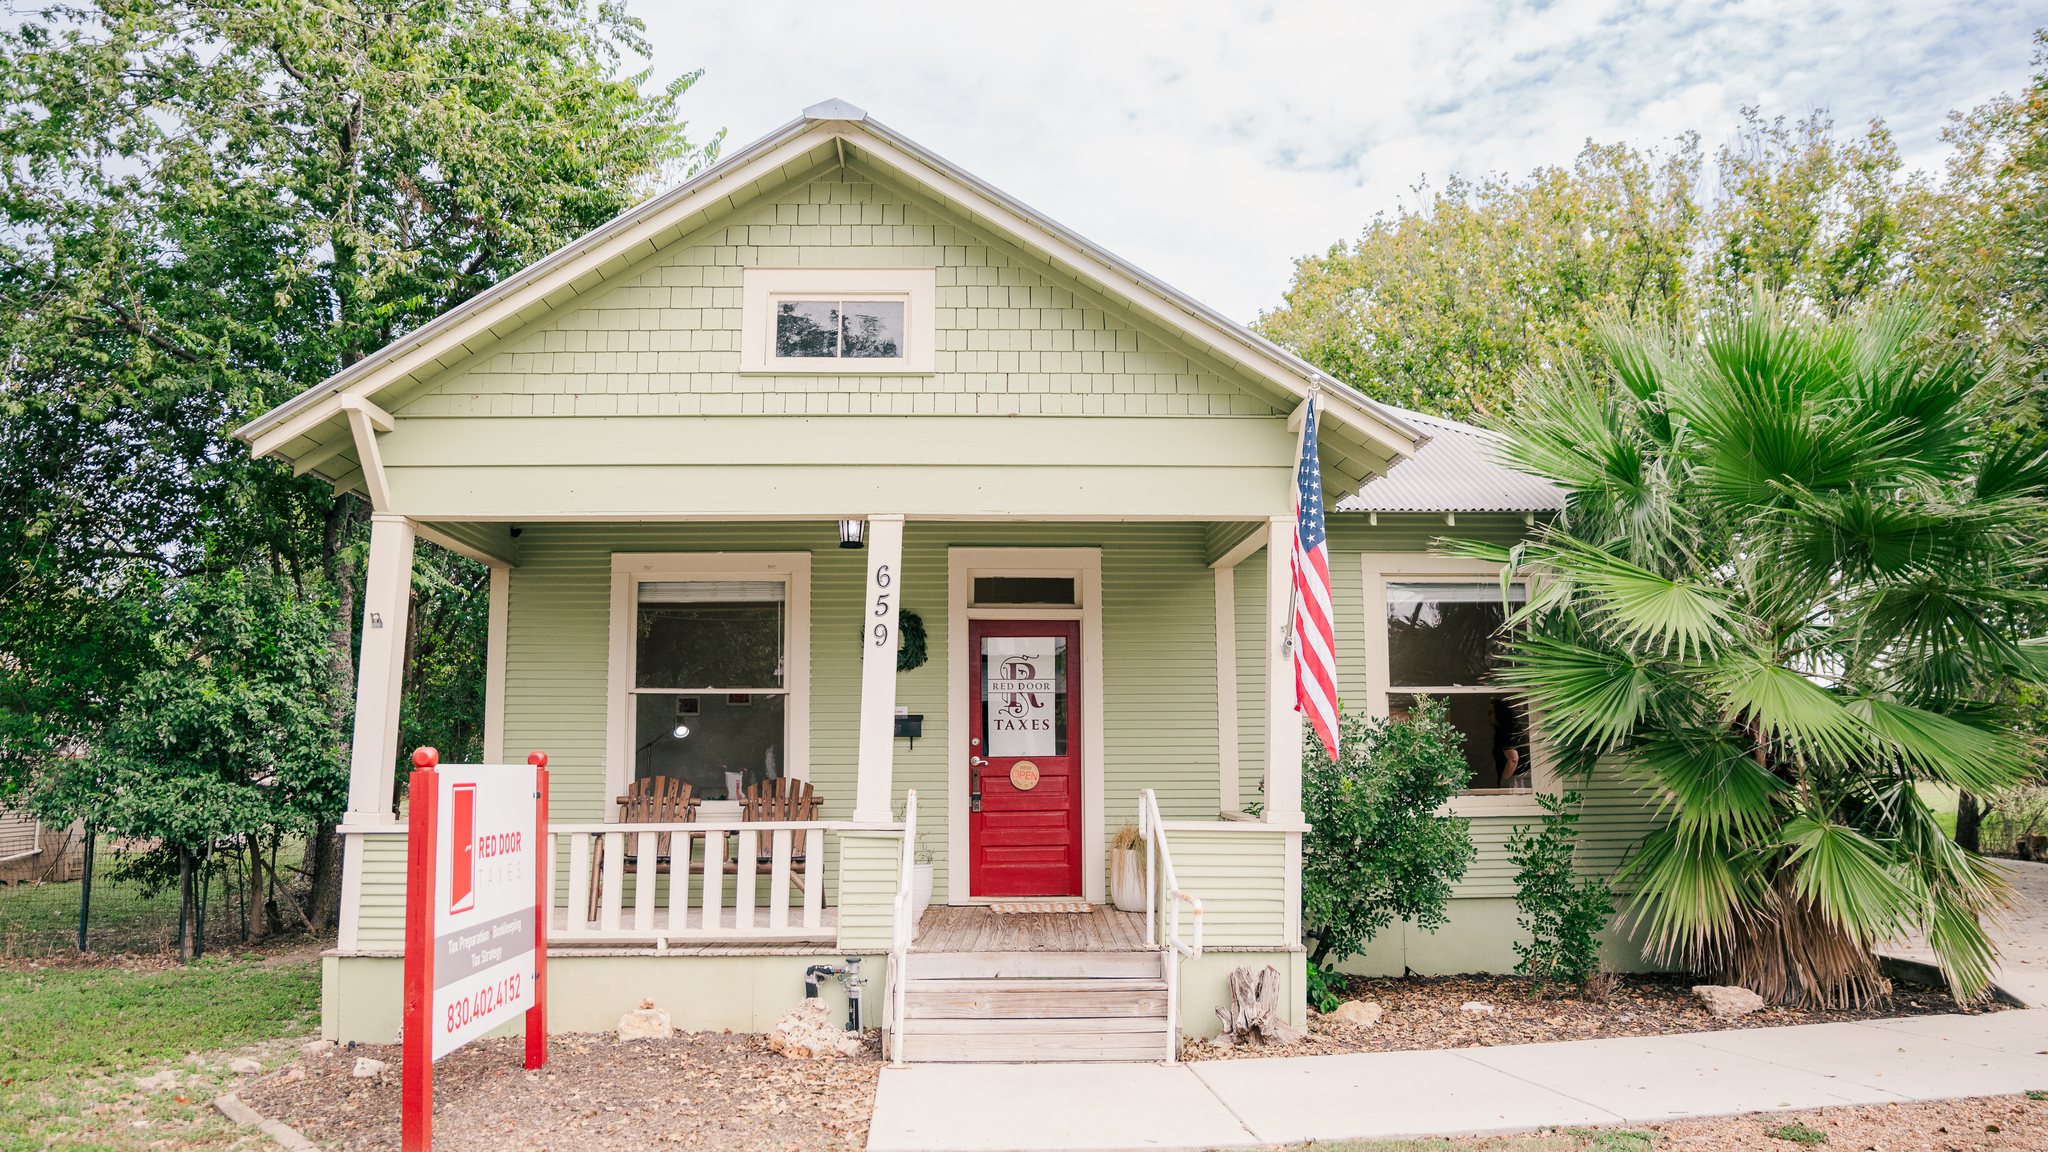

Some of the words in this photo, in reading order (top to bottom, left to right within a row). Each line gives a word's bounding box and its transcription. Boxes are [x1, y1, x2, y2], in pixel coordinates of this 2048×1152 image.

[874, 565, 891, 646] 659
[992, 682, 1014, 690] RED
[1018, 682, 1050, 690] DOOR
[994, 719, 1050, 731] TAXES
[1012, 770, 1038, 781] OPEN
[479, 836, 497, 859] RED
[499, 831, 521, 855] DOOR
[448, 939, 459, 955] Tax
[459, 928, 490, 951] Preparation
[493, 918, 521, 939] Bookkeeping
[471, 953, 481, 968] Tax
[481, 946, 503, 964] Strategy
[447, 973, 521, 1033] 830.402.4152
